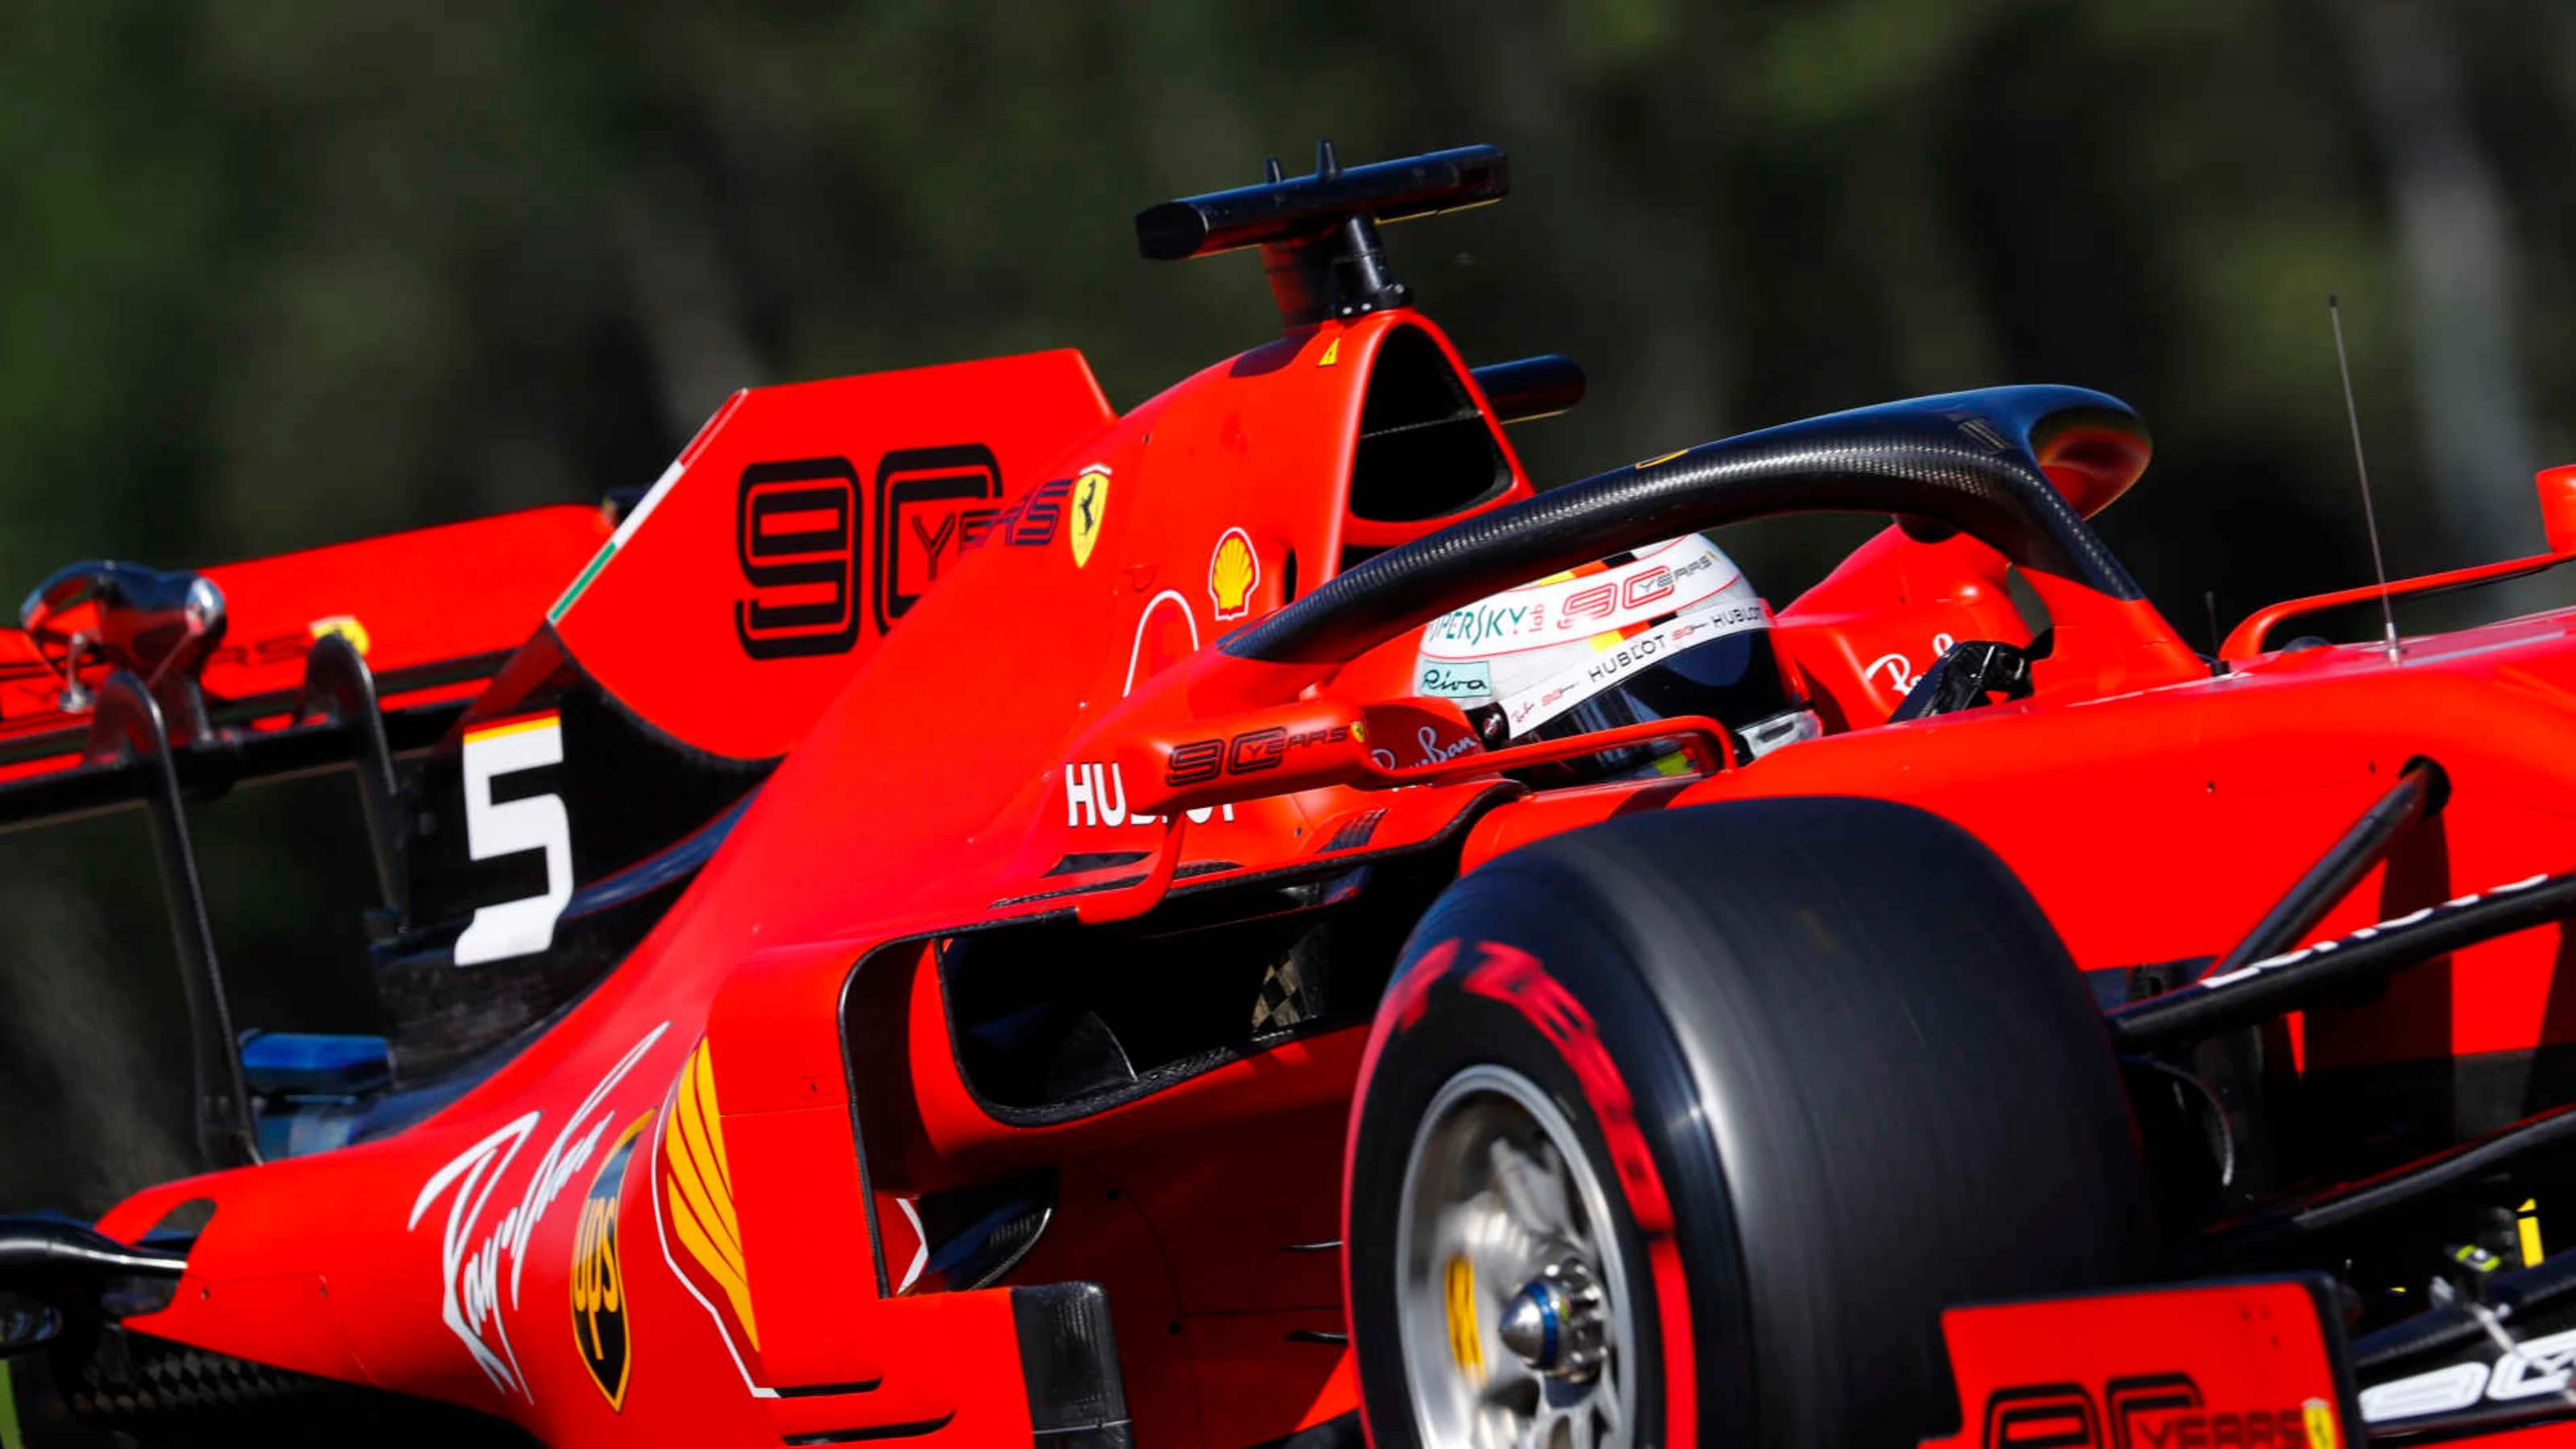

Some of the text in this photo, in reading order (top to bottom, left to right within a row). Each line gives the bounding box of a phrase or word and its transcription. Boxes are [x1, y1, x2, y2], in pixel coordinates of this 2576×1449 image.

[734, 443, 1003, 661] 90
[1556, 564, 1676, 630] 90
[1422, 668, 1487, 691] Riva
[1586, 634, 1666, 683] HUBLOT
[1165, 726, 1350, 787] 90 YEARS
[454, 715, 573, 966] 5
[570, 1196, 622, 1360] ups
